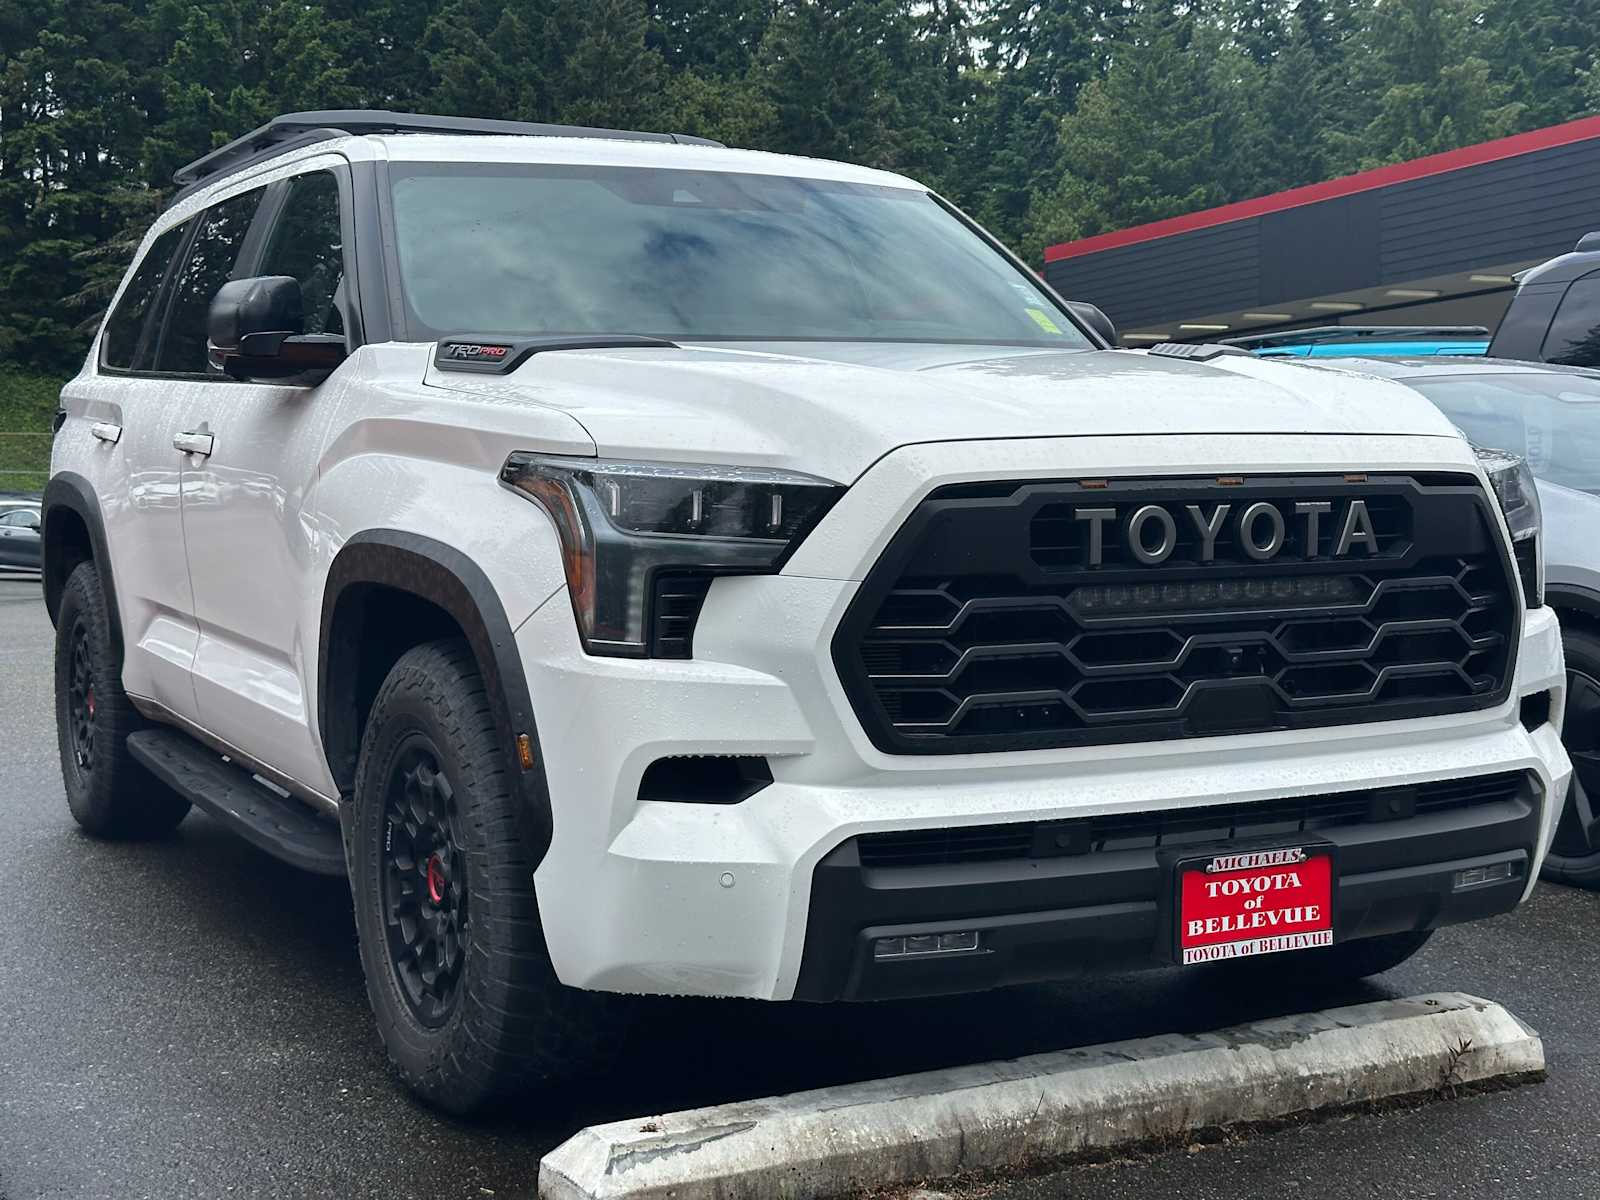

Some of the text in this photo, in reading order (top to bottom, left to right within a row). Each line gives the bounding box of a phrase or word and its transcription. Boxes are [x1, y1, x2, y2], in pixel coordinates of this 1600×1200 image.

[1075, 500, 1379, 566] TOYOTA
[1214, 849, 1301, 870] MICHAELS
[1205, 872, 1301, 897] TOYOTA
[1243, 895, 1264, 909] of
[1187, 905, 1320, 936] BELLEVUE
[1184, 932, 1332, 963] TOYOTA of BELLEVUE
